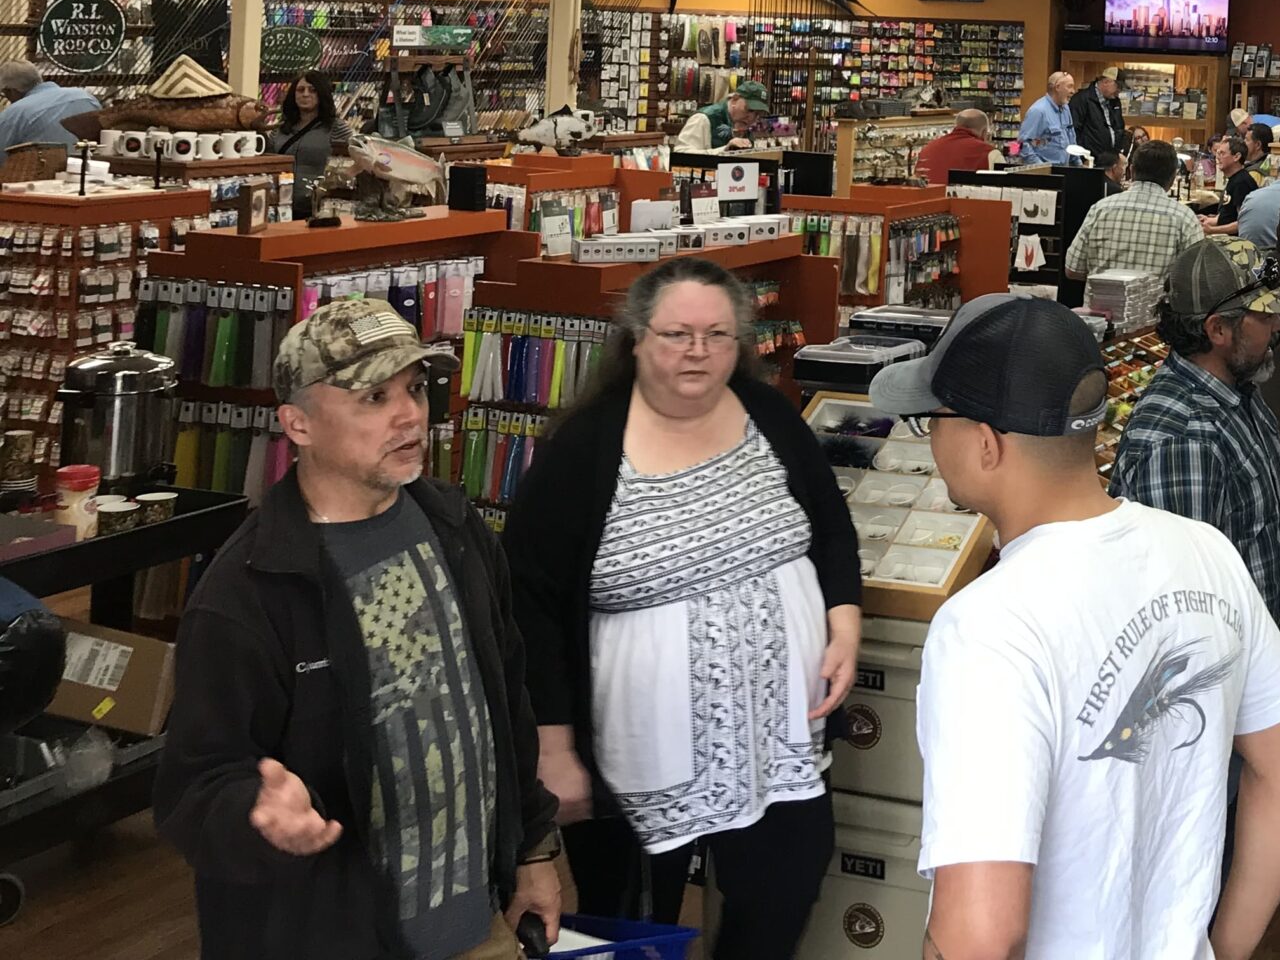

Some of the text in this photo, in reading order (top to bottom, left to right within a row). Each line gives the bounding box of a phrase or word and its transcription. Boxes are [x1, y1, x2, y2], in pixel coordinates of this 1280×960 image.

[53, 39, 86, 55] ROD
[1076, 650, 1123, 729] FIRST
[1114, 606, 1153, 660] RULE
[1151, 593, 1171, 623] OF
[1172, 589, 1217, 616] FIGHT
[855, 671, 882, 688] ETI
[844, 855, 882, 876] YETI
